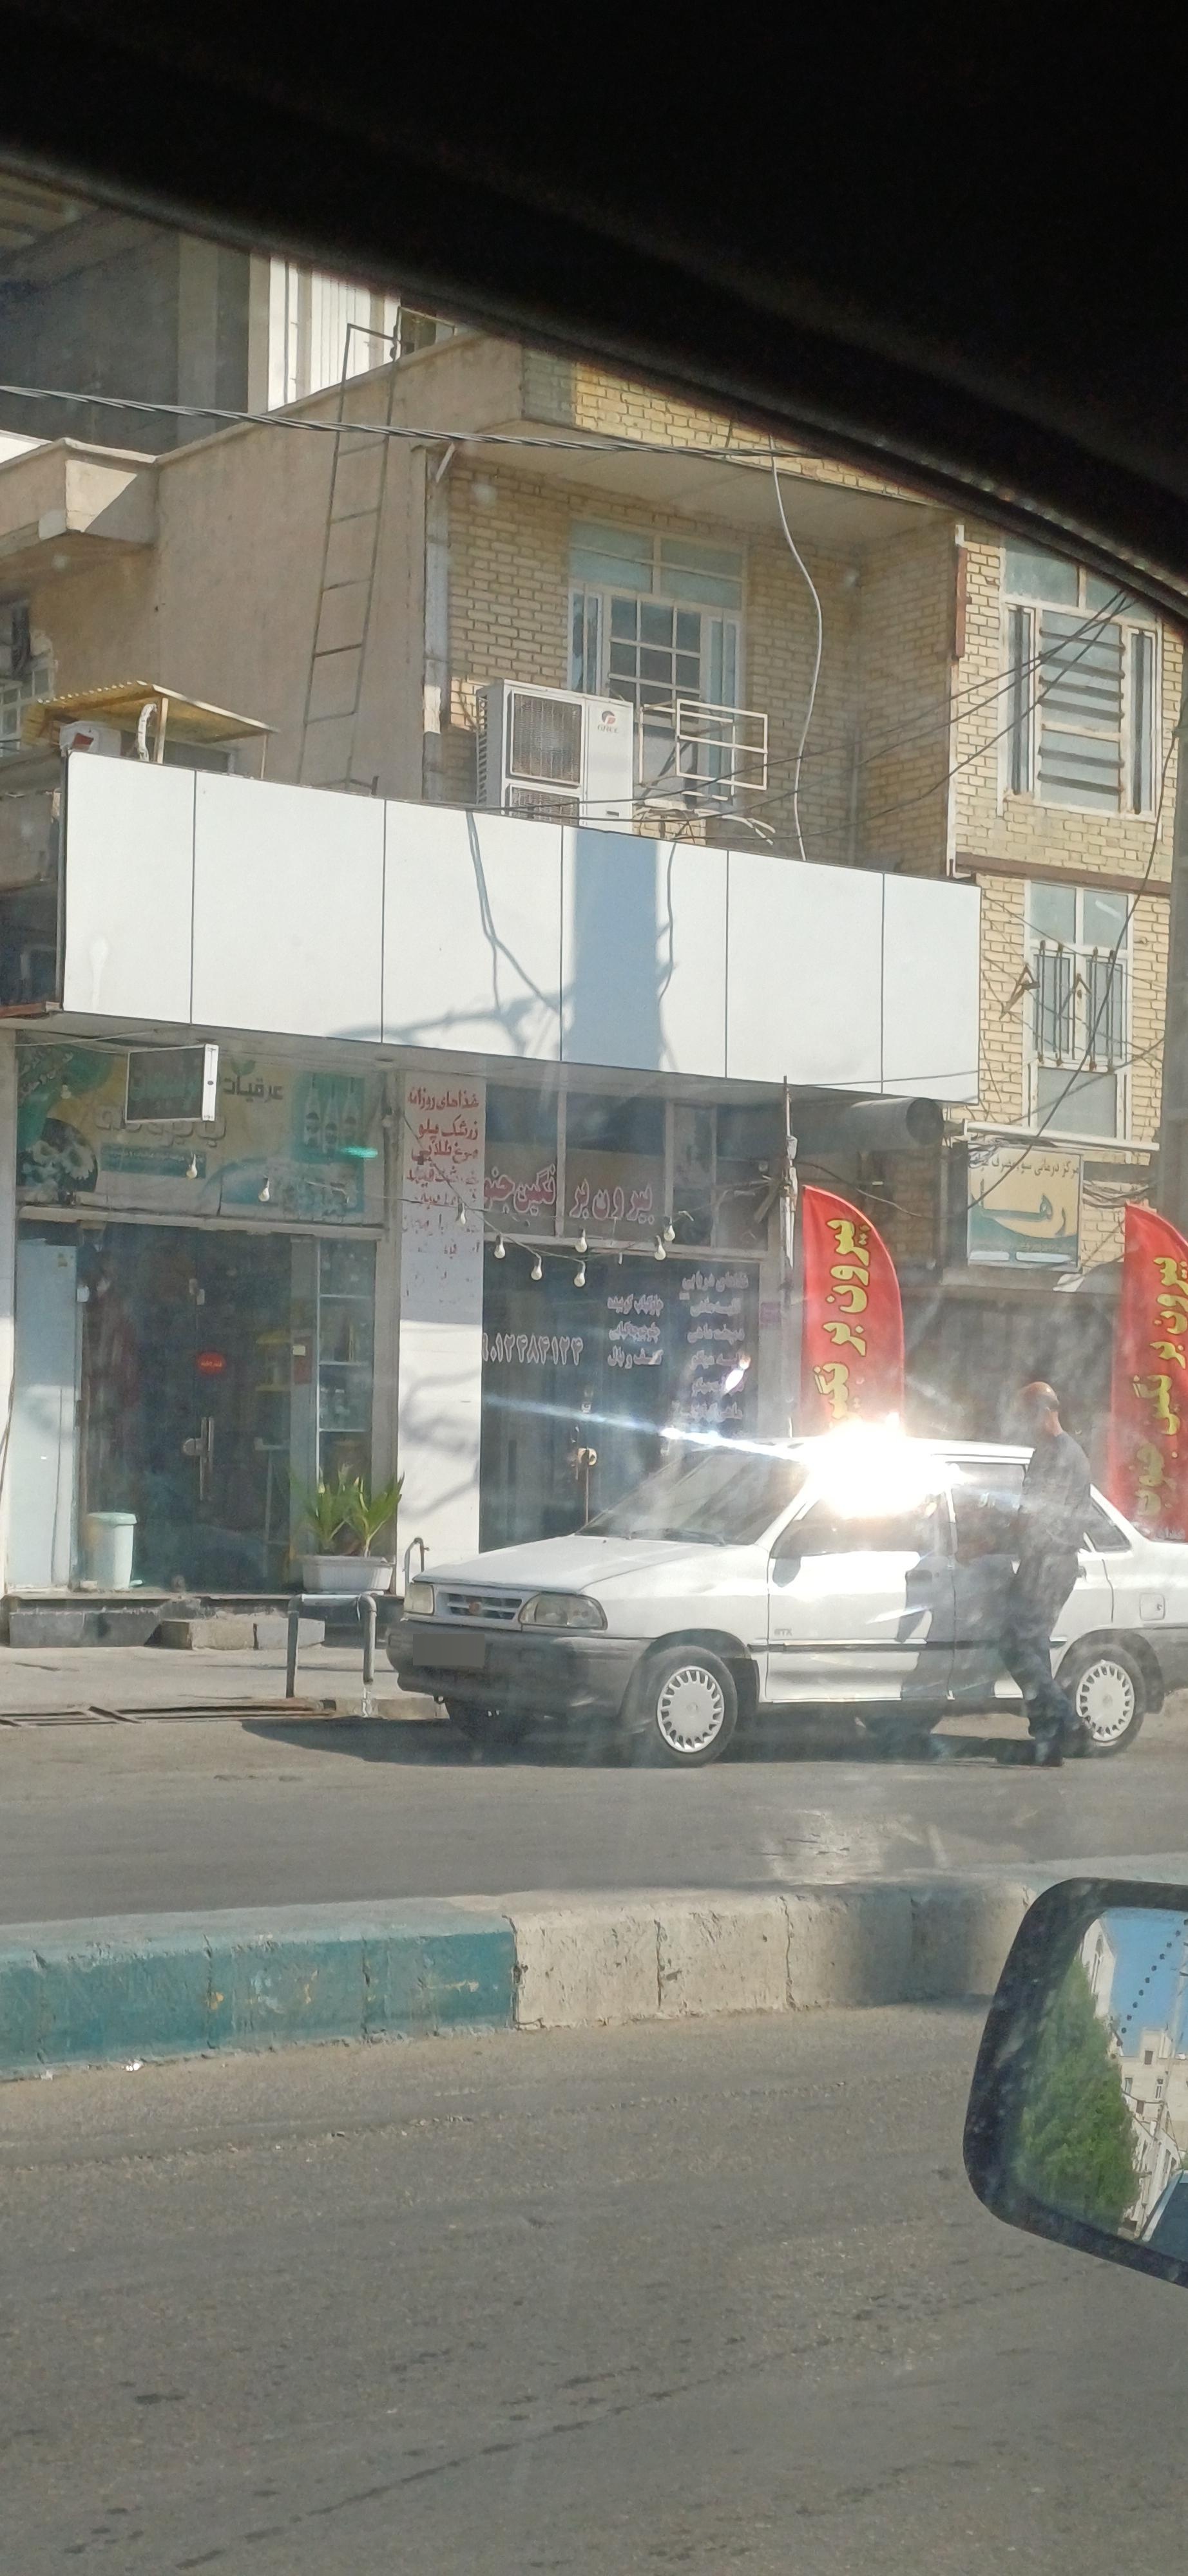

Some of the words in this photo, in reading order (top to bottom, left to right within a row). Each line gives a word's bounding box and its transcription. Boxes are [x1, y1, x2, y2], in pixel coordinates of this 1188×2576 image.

[436, 1089, 479, 1110] غذاهای
[418, 1117, 439, 1144] پلو
[441, 1114, 479, 1141] زرشک
[452, 1141, 479, 1164] مرغ
[1034, 1156, 1059, 1177] درمانی
[1061, 1160, 1080, 1179] مرکز
[513, 1163, 557, 1217] نگین
[568, 1177, 590, 1219] بر
[591, 1182, 655, 1225] بیرون
[826, 1219, 871, 1313] بیرون
[1152, 1256, 1188, 1335] بیرون
[821, 1321, 867, 1358] بر
[1149, 1341, 1187, 1370] بر
